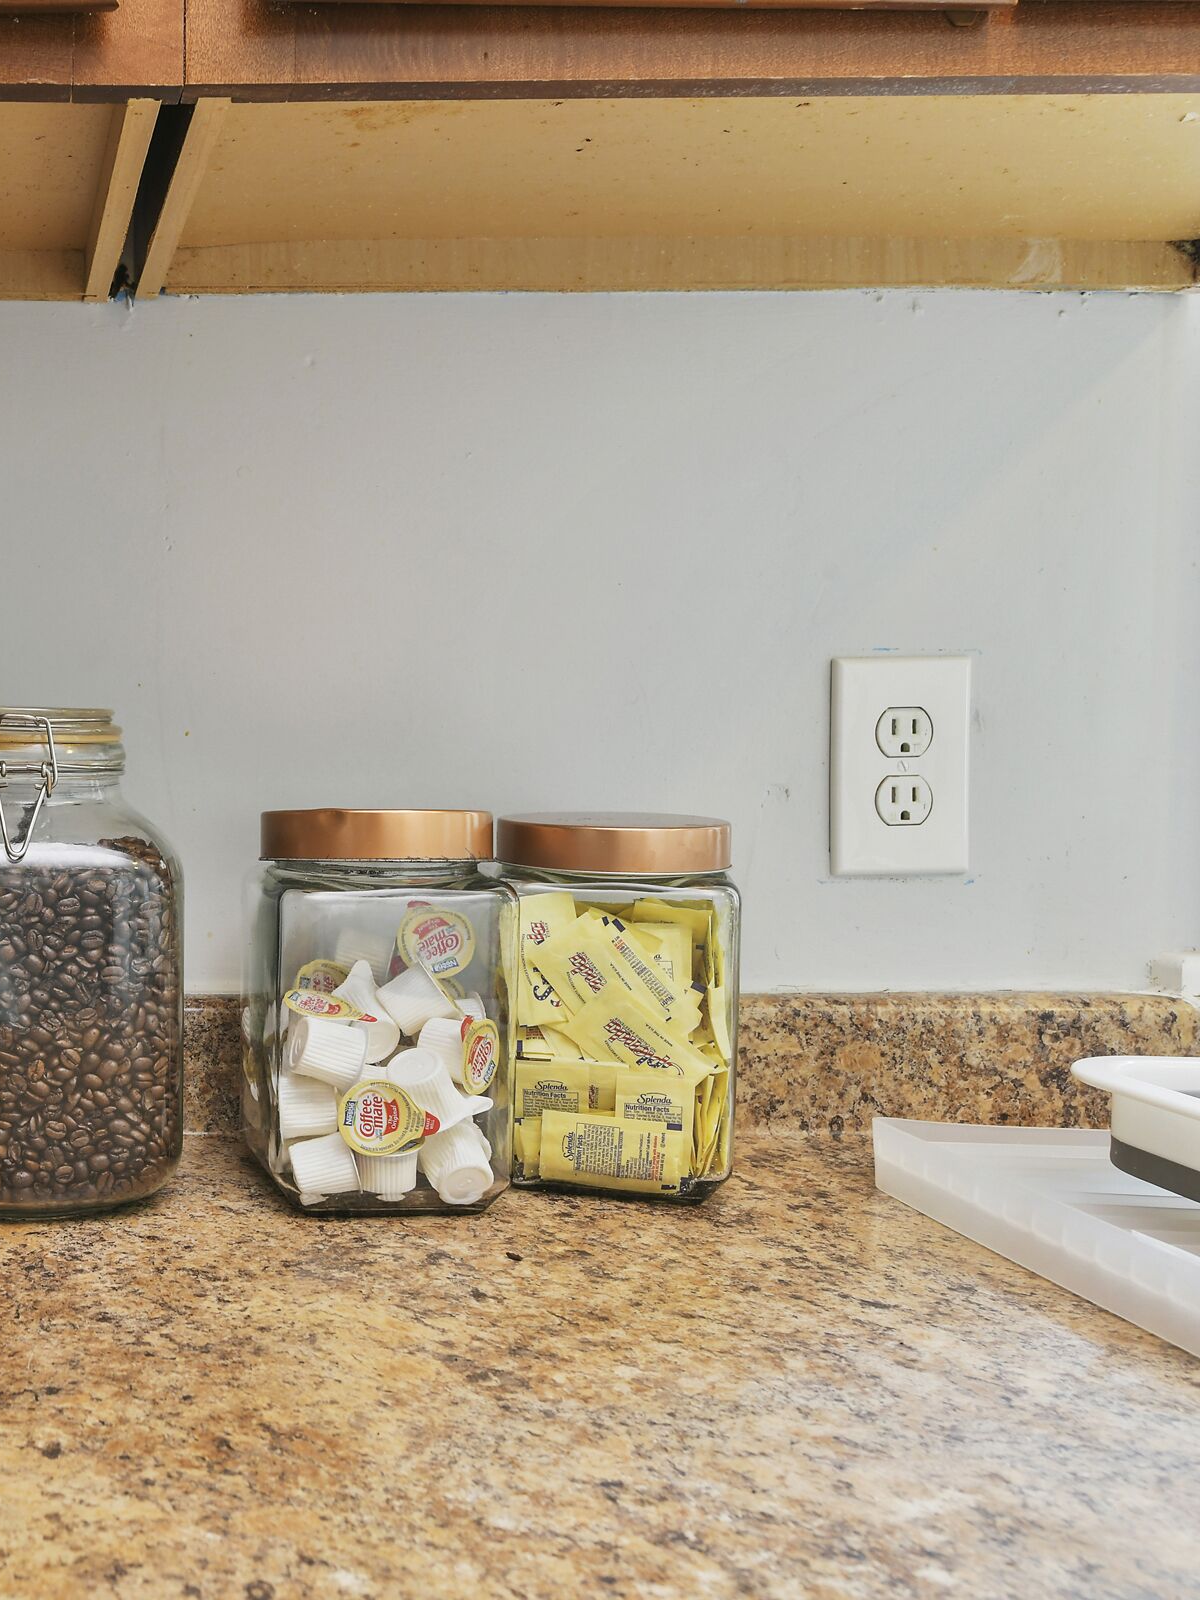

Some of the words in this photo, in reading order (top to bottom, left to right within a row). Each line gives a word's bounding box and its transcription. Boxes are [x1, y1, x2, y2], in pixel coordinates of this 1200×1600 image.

[535, 1080, 568, 1091] Splenda
[637, 1093, 672, 1105] Splenda
[360, 1099, 374, 1137] Coffee
[373, 1097, 383, 1128] mate
[562, 1132, 574, 1161] Splenda
